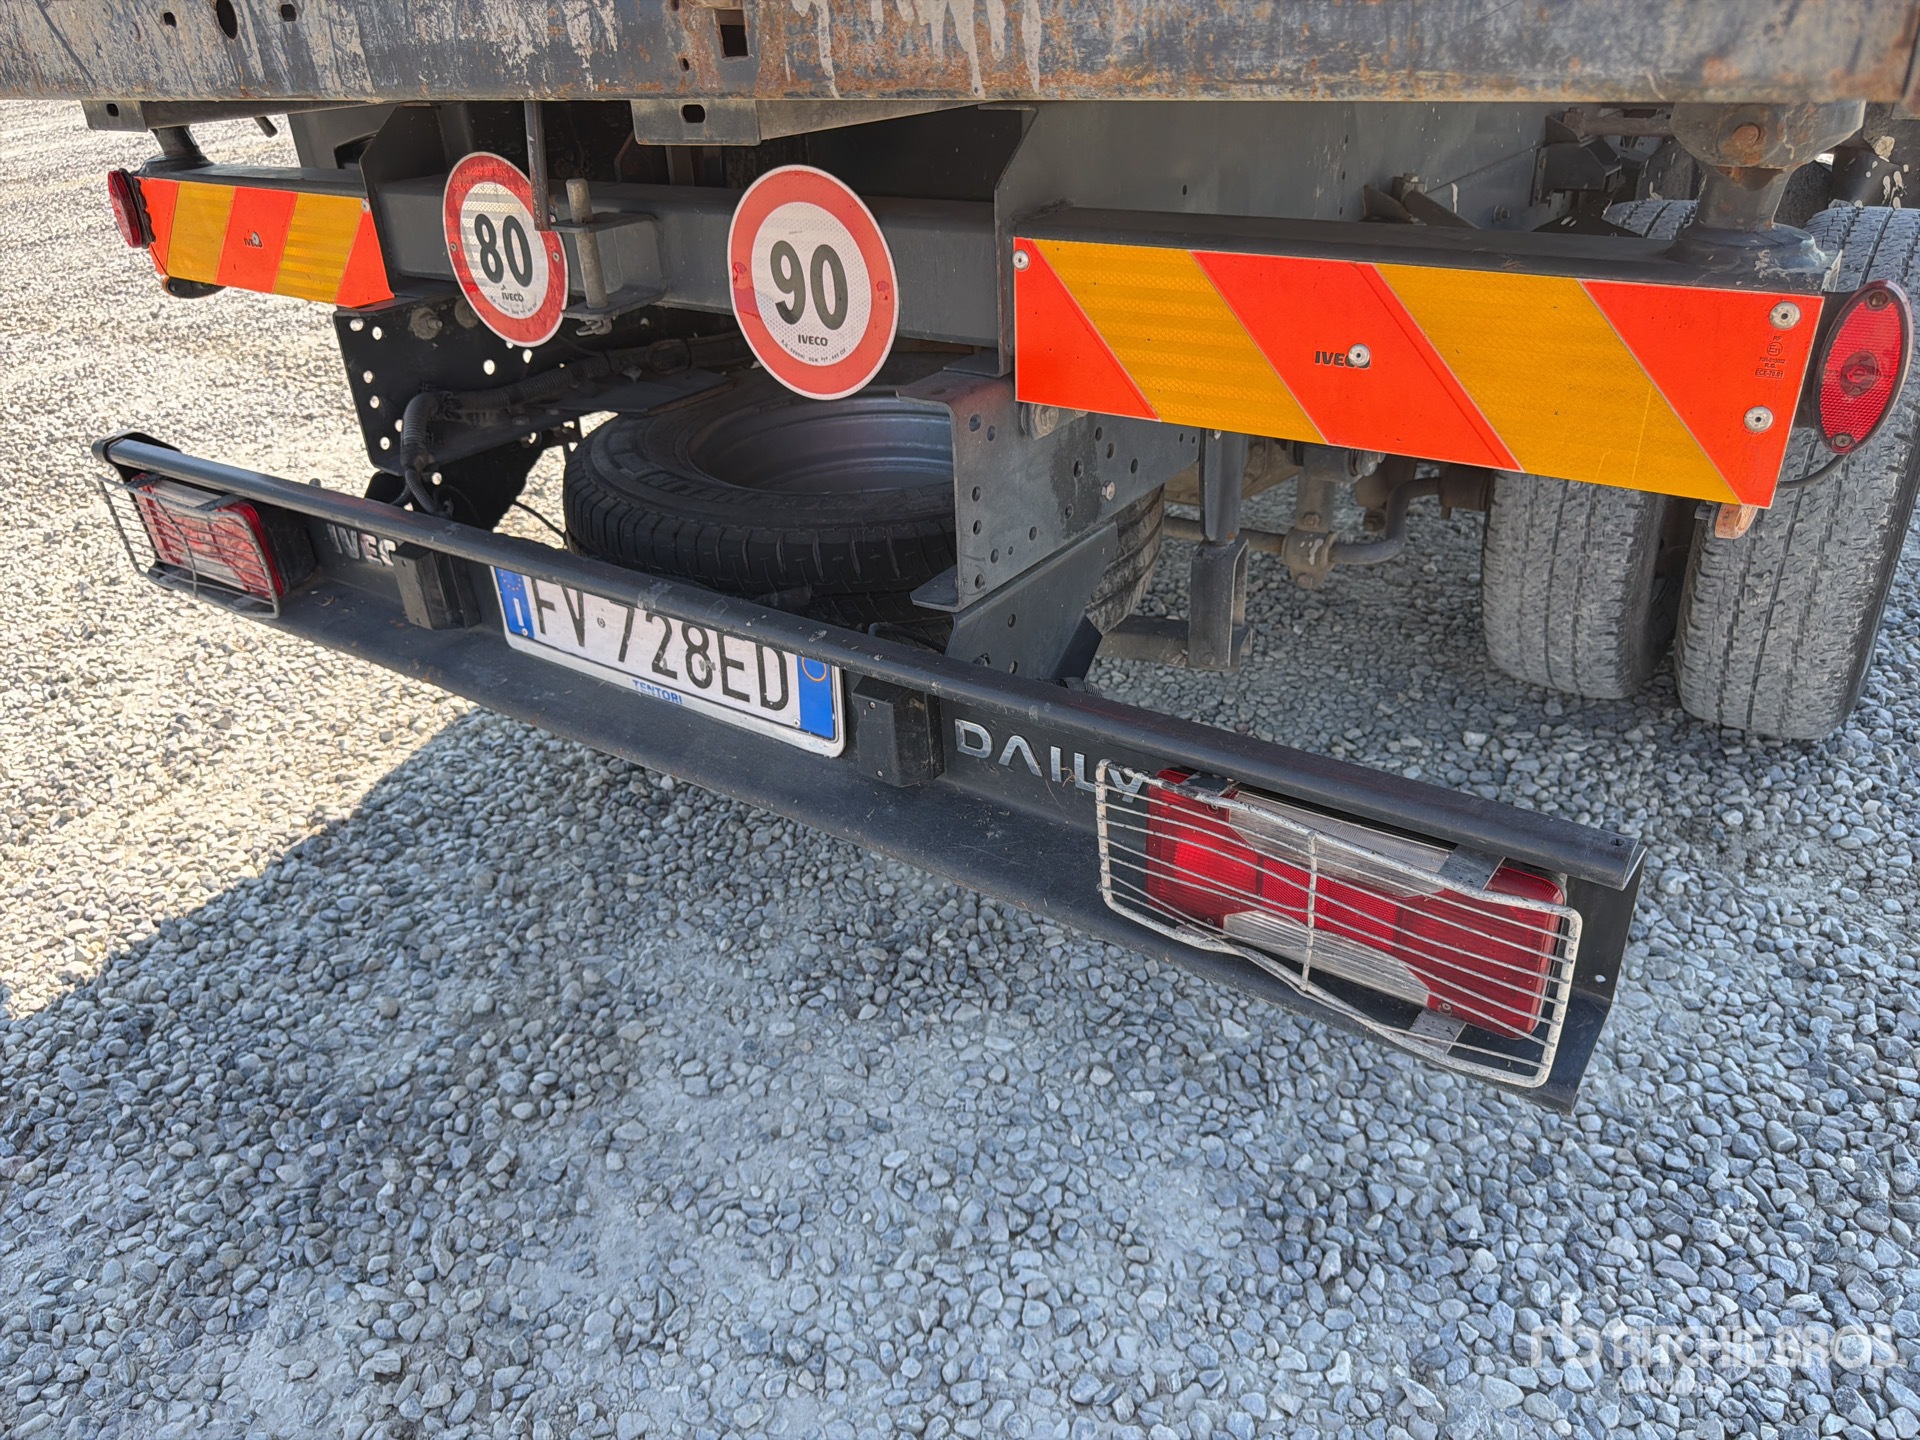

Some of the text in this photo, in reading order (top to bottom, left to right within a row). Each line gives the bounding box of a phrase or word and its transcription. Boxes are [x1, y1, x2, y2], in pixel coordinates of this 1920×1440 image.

[474, 213, 533, 288] 80
[502, 292, 525, 303] IVECO
[770, 240, 849, 330] 90
[797, 334, 829, 347] IVECO
[1314, 350, 1371, 369] IVE
[632, 679, 684, 705] TENTORI
[954, 718, 1145, 804] DAILY
